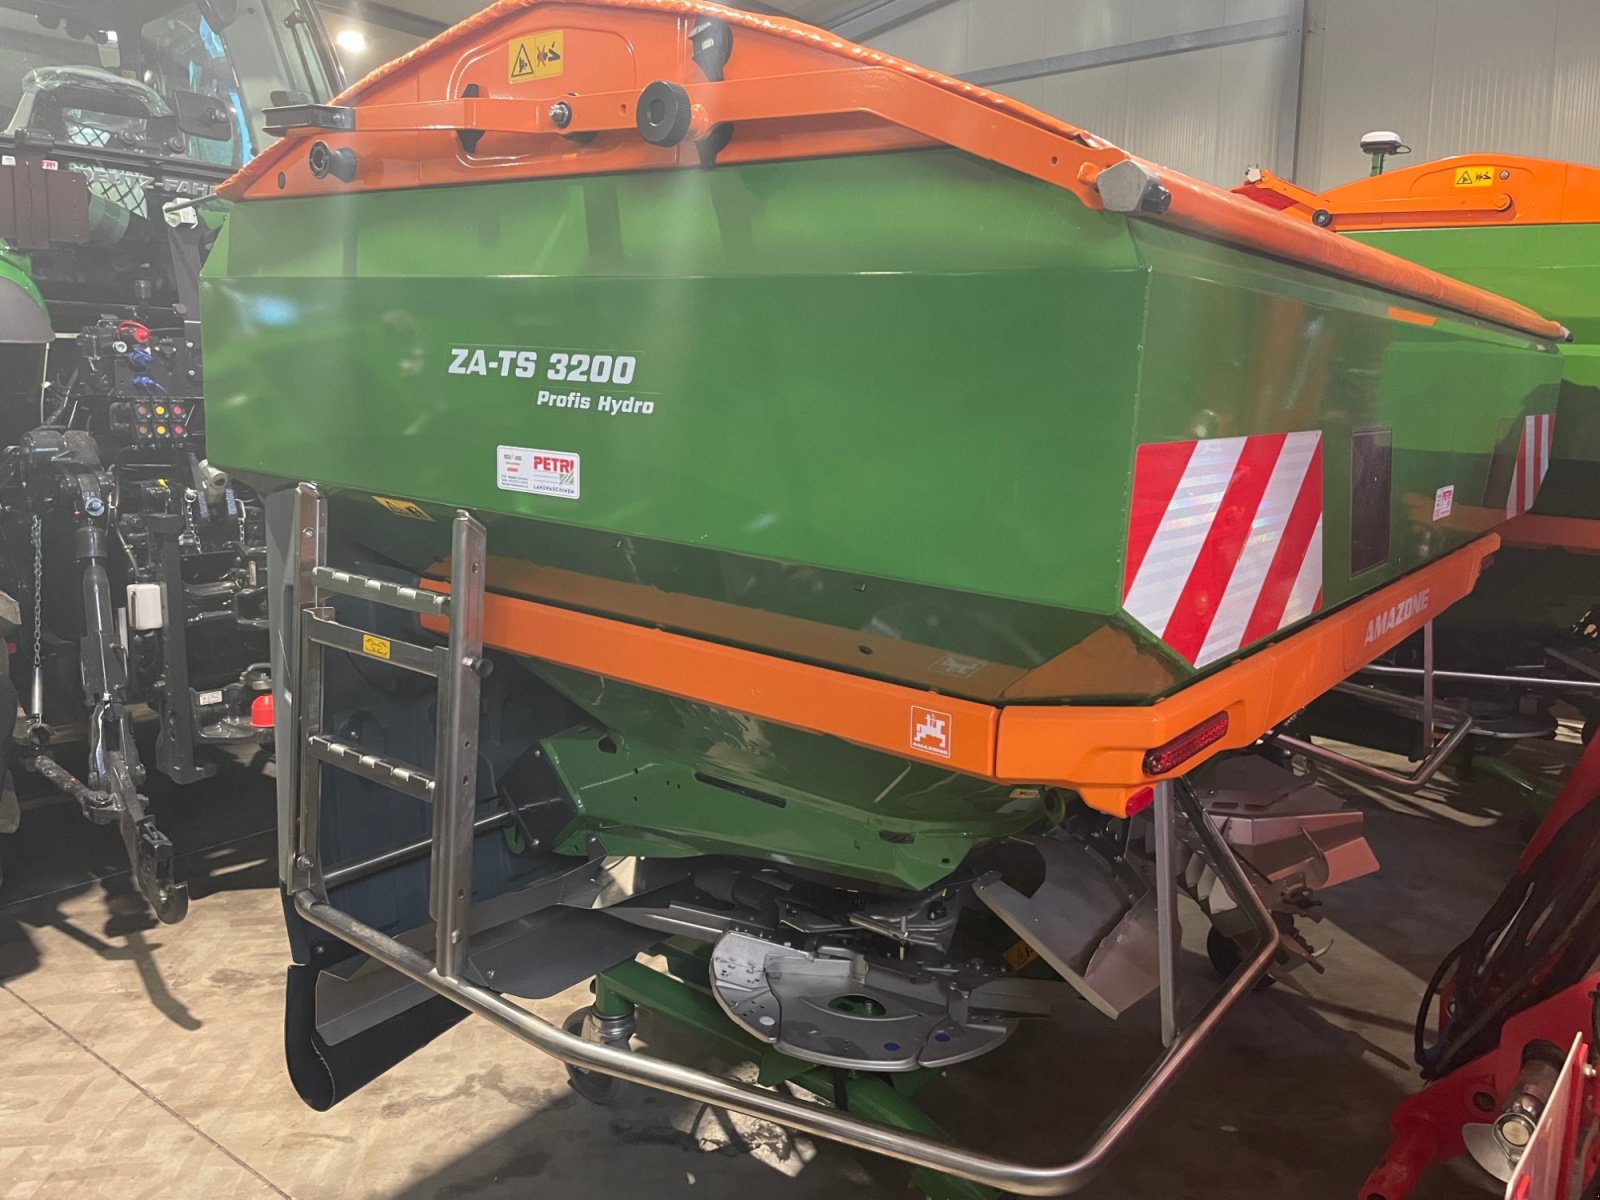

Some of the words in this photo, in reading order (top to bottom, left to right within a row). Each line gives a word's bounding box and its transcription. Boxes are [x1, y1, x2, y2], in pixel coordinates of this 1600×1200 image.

[448, 348, 538, 378] ZA-TS
[547, 353, 636, 384] 3200
[536, 390, 591, 409] Profis
[598, 395, 654, 415] Hydro
[533, 456, 575, 473] PETRI
[1363, 588, 1430, 648] AMAZONE
